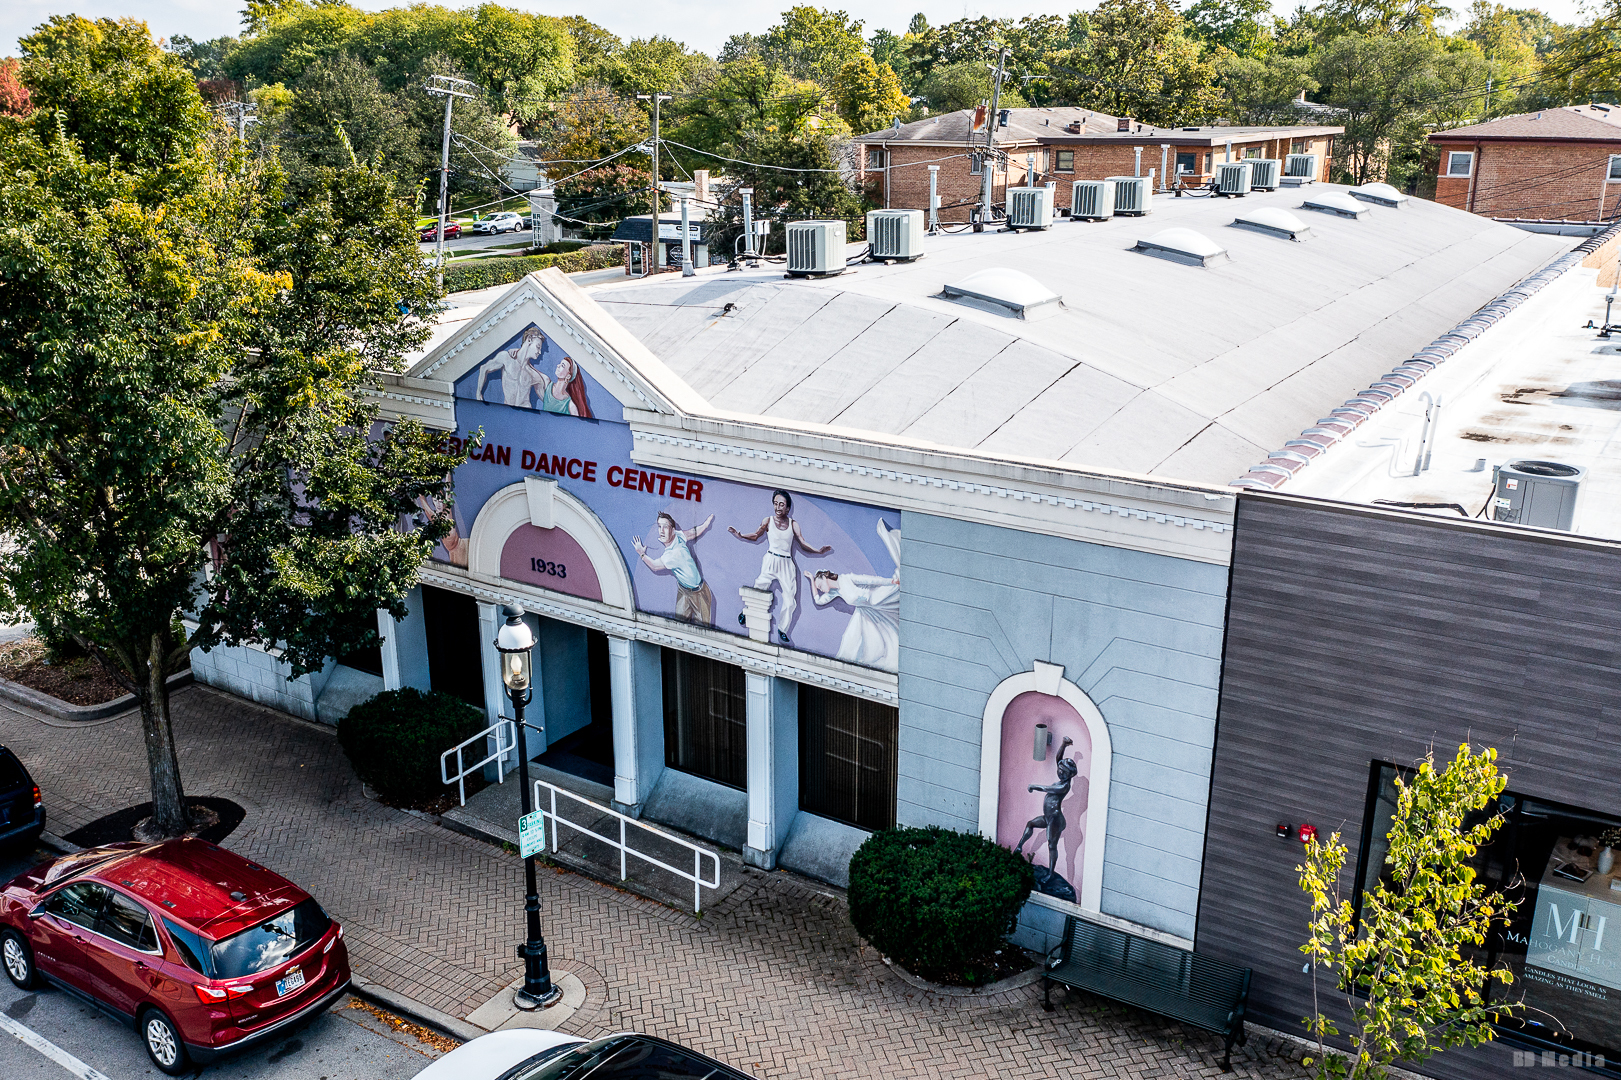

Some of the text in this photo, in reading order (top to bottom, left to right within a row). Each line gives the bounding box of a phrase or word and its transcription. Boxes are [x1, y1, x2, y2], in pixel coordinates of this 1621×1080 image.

[411, 429, 705, 502] ERICAN DANCE CENTER
[530, 556, 567, 579] 1933
[521, 819, 527, 831] 3
[1543, 902, 1609, 951] MH
[1507, 930, 1582, 959] MAHOGANY
[1547, 954, 1592, 974] CANDLES
[1523, 973, 1608, 1001] AMAZING AS THEY SMELL
[1524, 966, 1608, 995] CANDLES THAT LOOK AS
